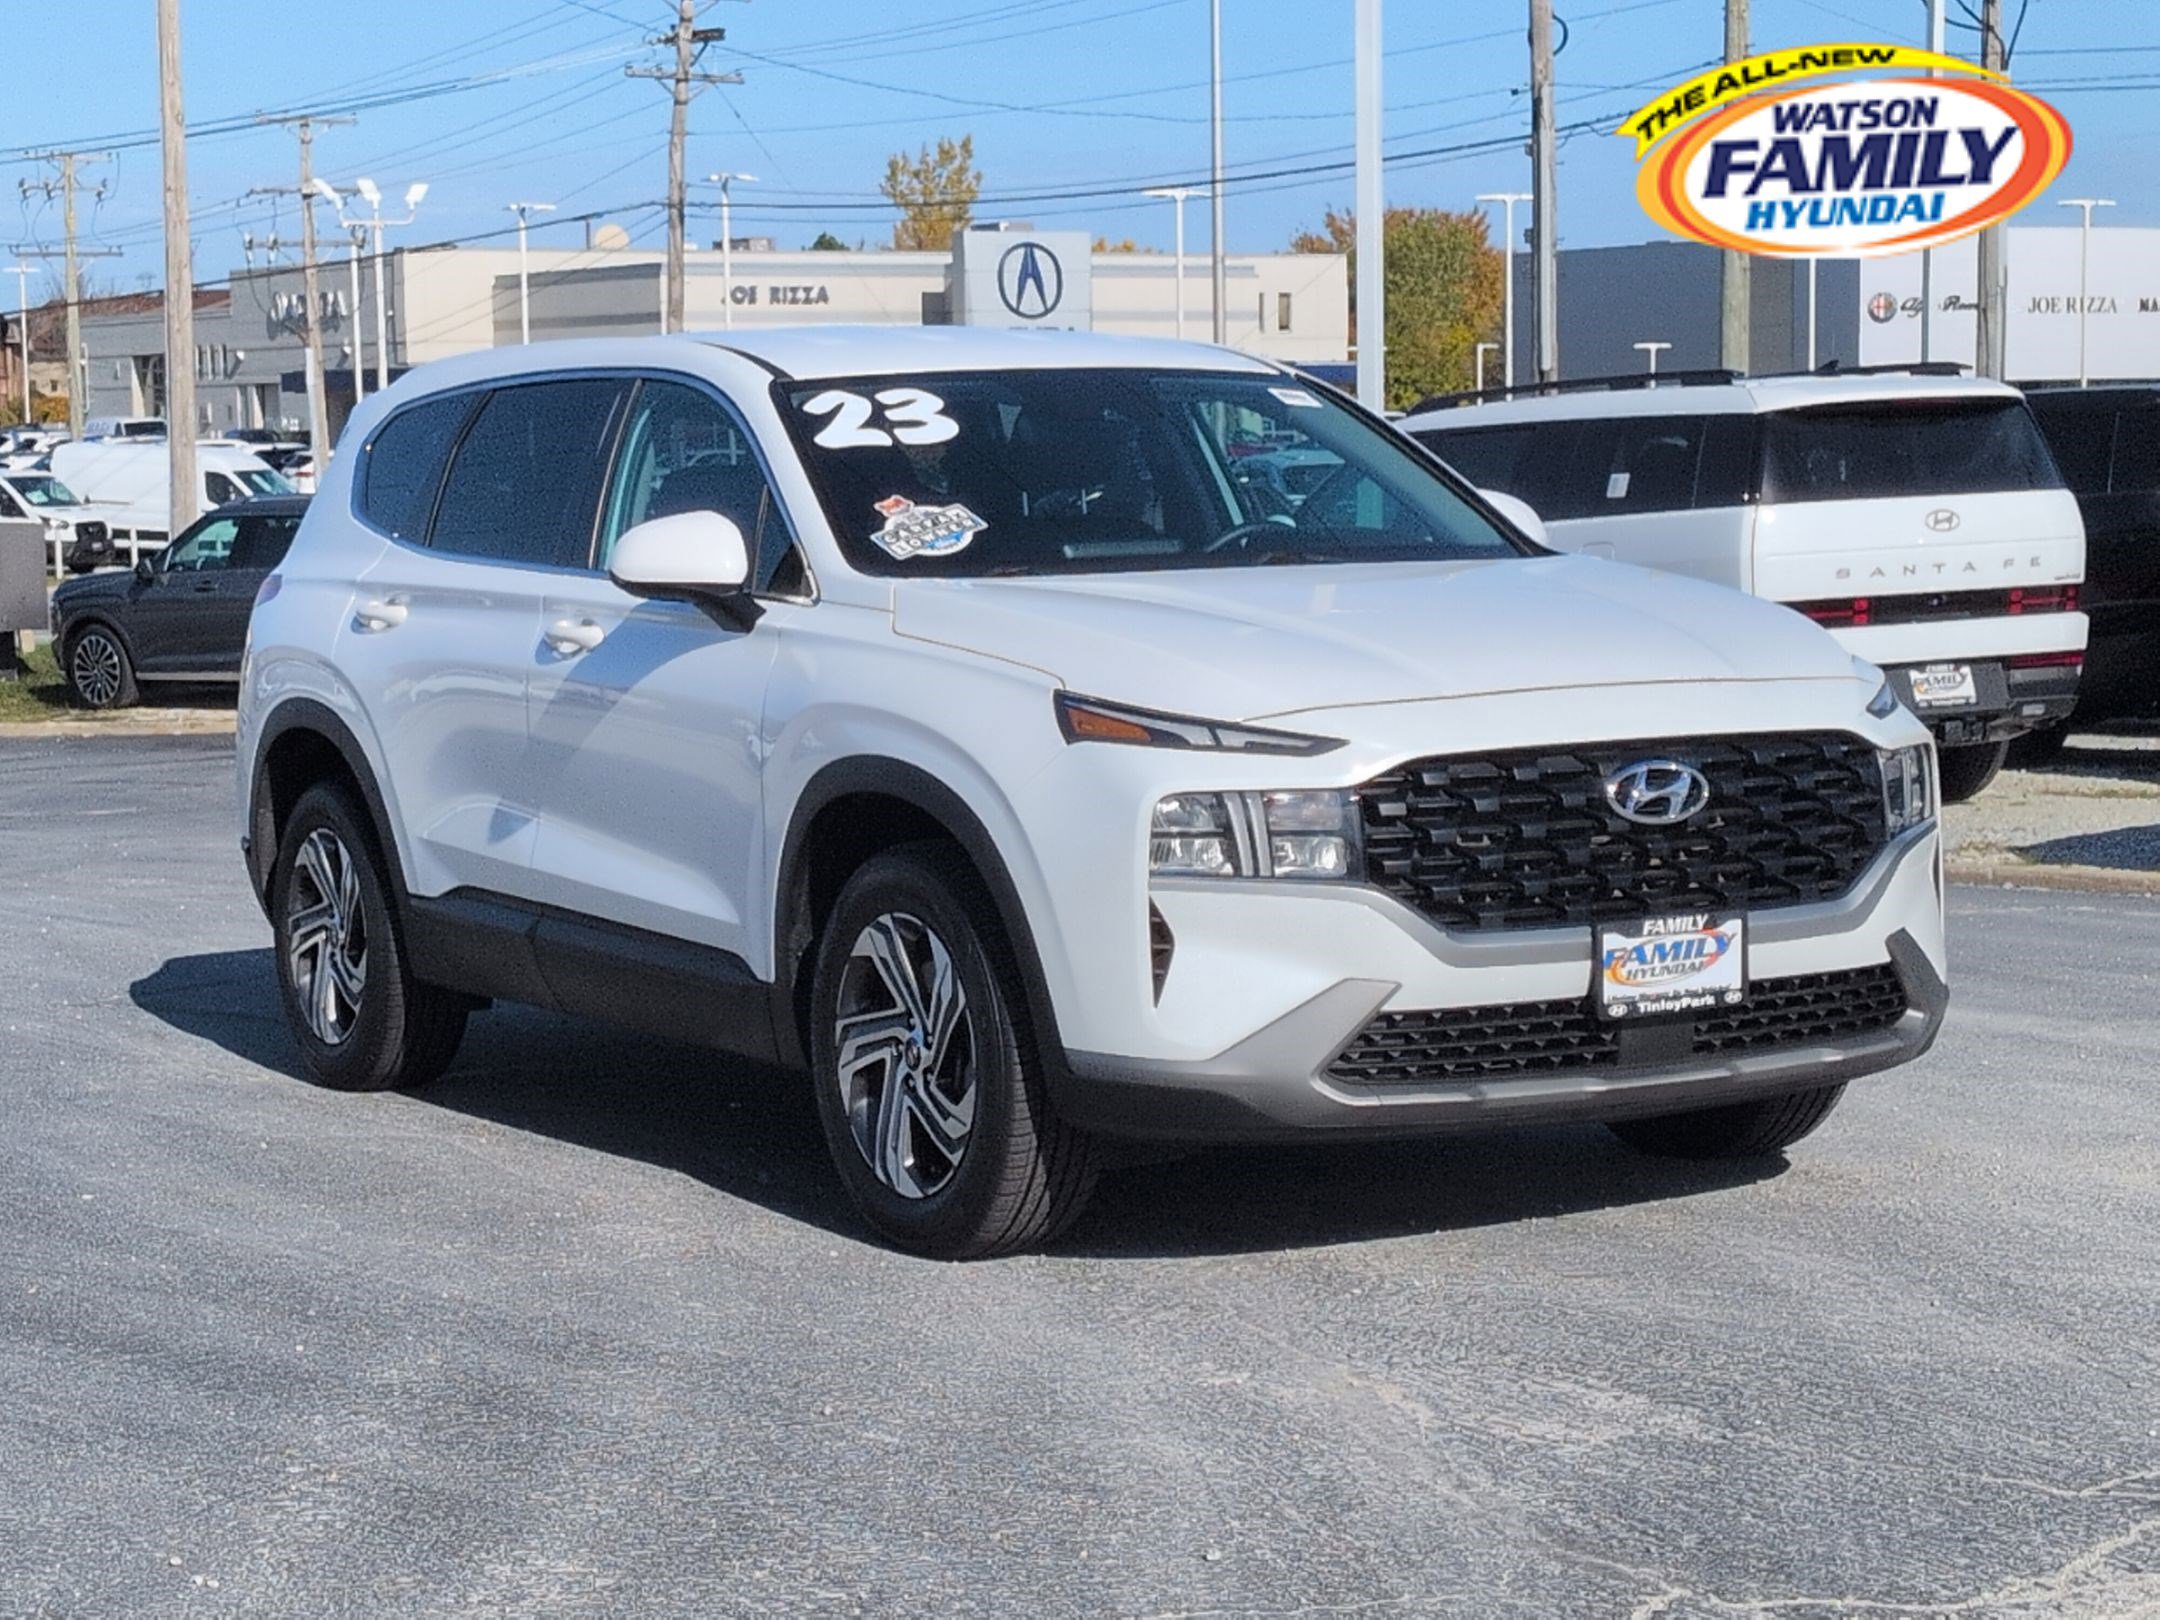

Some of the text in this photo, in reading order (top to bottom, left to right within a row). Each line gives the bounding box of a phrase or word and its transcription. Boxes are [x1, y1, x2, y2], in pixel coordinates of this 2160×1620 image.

[720, 285, 830, 305] OE RIZZA
[2027, 296, 2118, 314] JOE RIZZA
[802, 388, 960, 449] 23
[1835, 555, 2041, 580] SANTA FE
[1643, 913, 1709, 936] FAMILY
[1602, 932, 1737, 970] FAMILY
[1626, 960, 1707, 981] HYUNDAI
